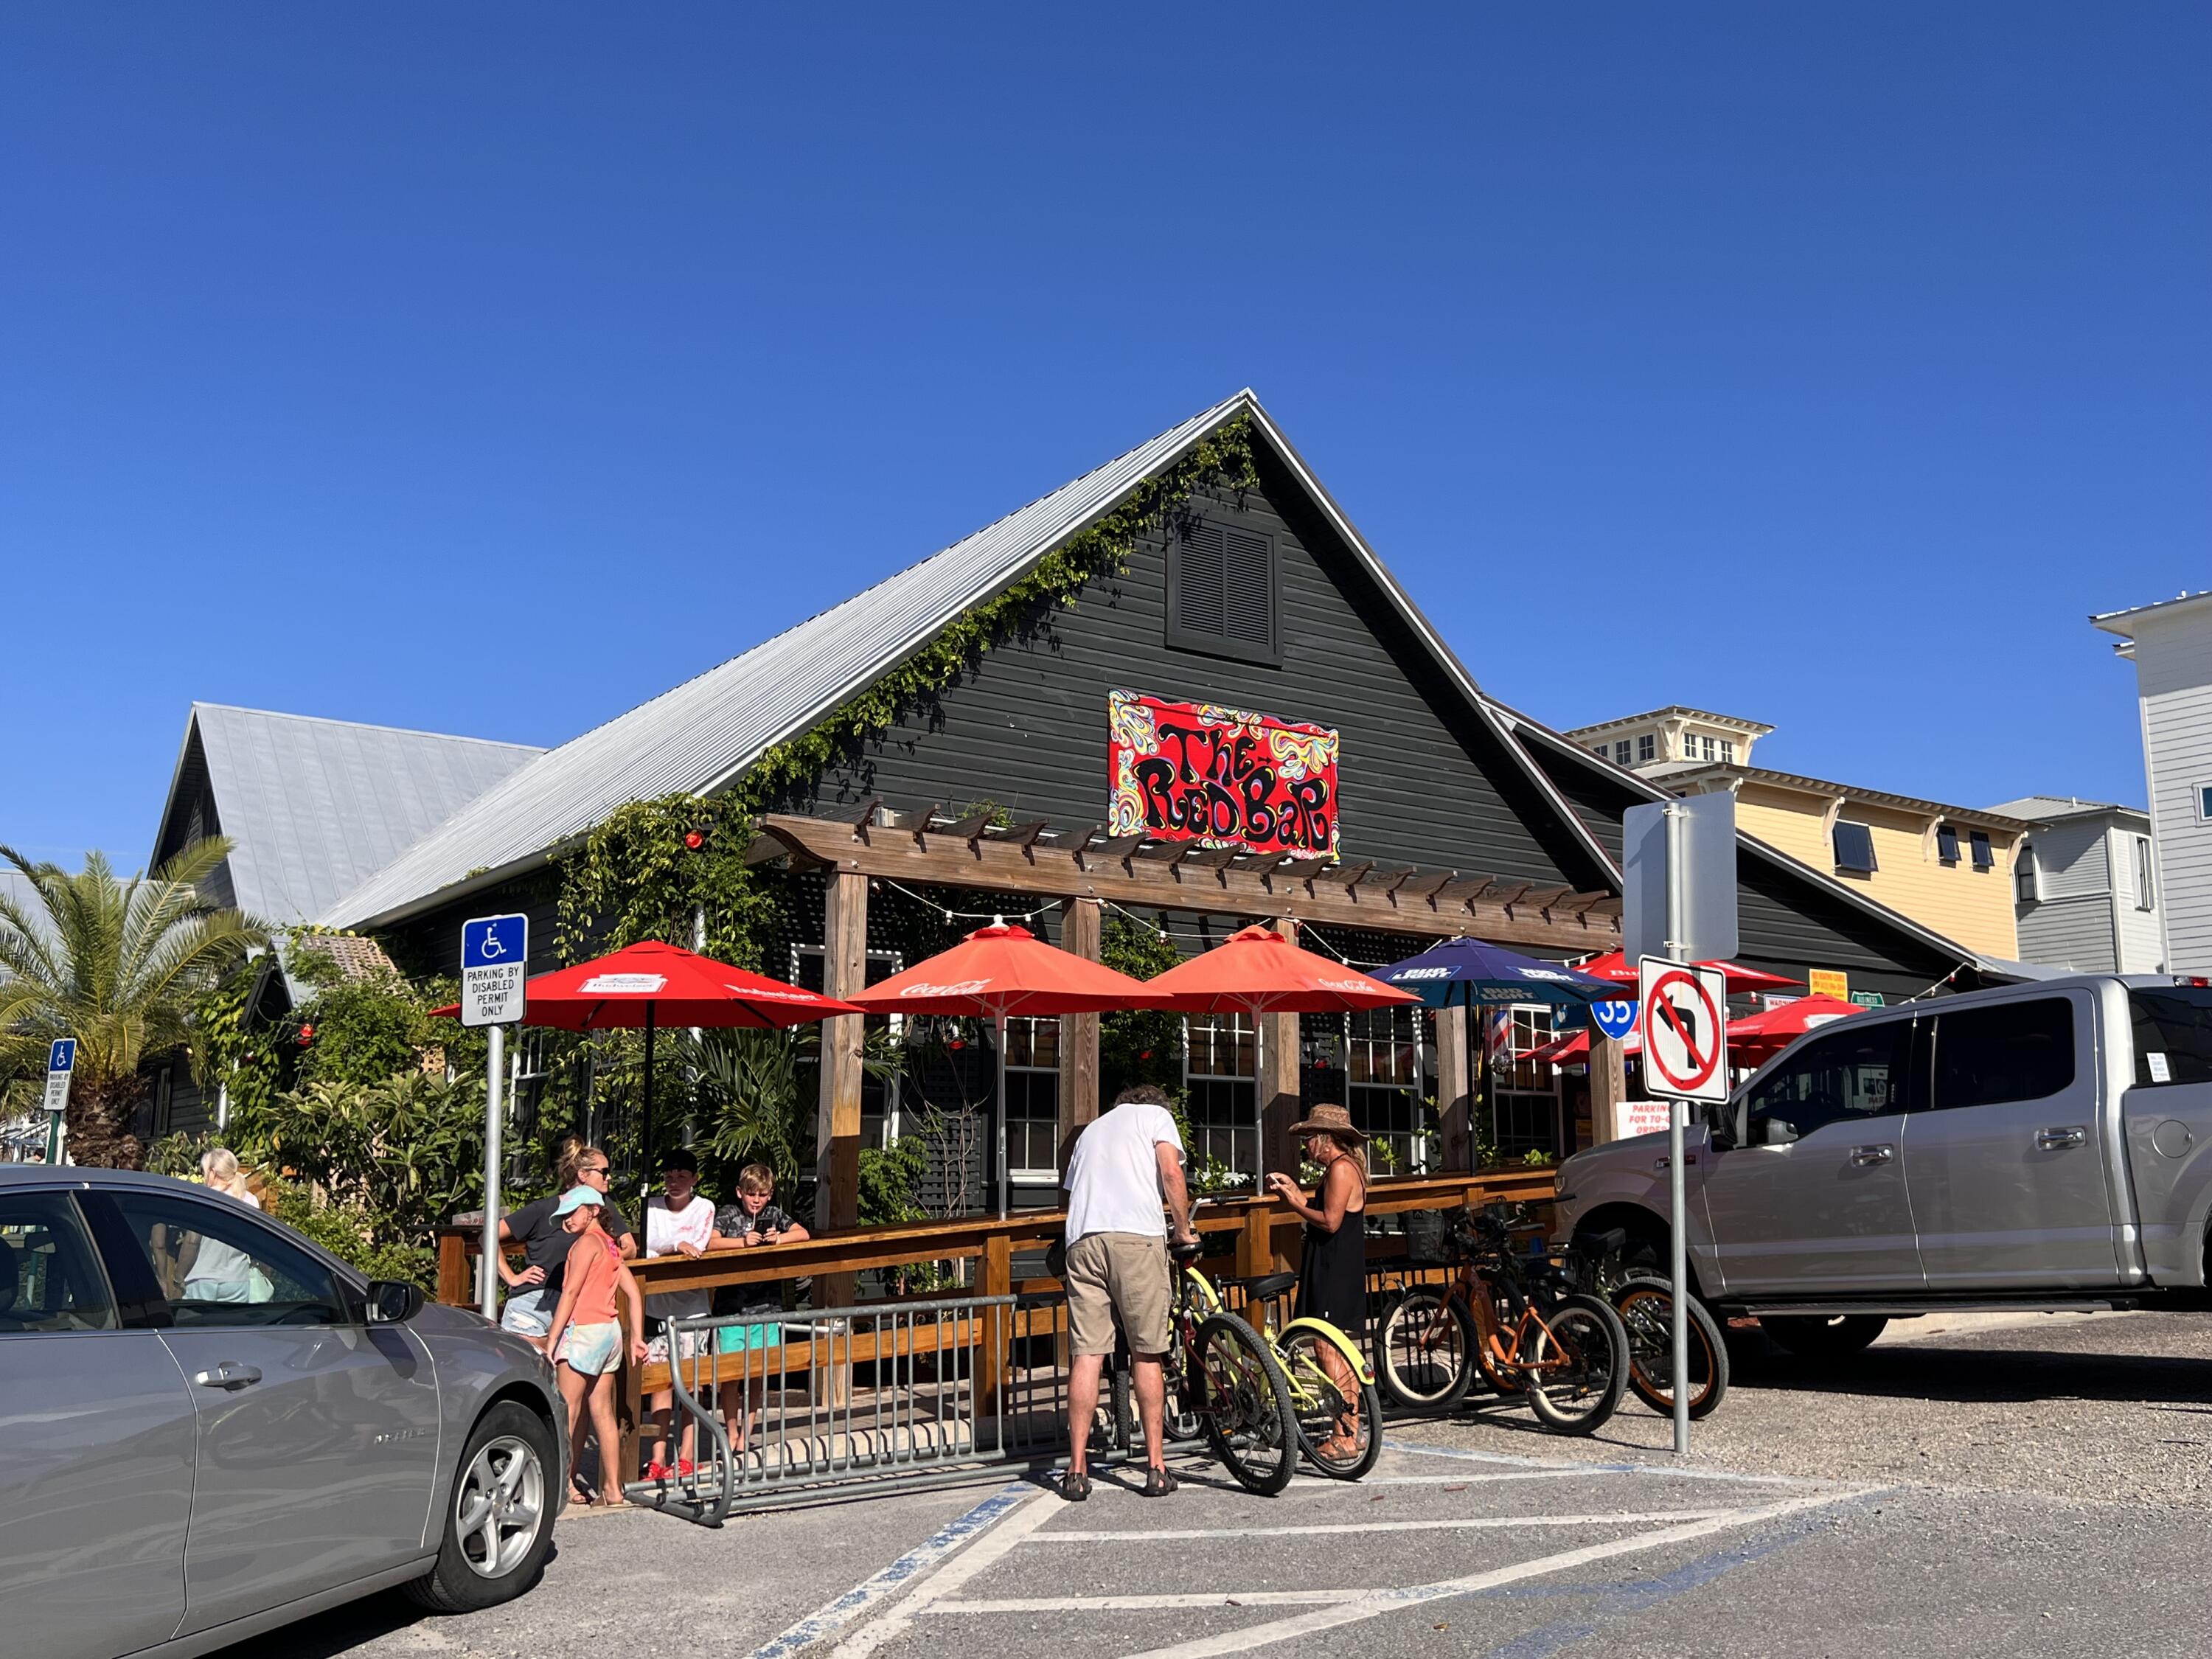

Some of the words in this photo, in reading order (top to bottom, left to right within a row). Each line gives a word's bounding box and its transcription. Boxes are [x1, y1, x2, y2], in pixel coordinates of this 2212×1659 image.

[467, 967, 504, 981] PARKING
[508, 967, 519, 977] BY
[1391, 972, 1452, 980] LIGHT
[472, 979, 514, 993] DISABLED
[477, 992, 508, 1005] PERMIT
[481, 1004, 504, 1017] ONLY
[1599, 1001, 1631, 1023] 35
[1629, 1116, 1647, 1124] FOR
